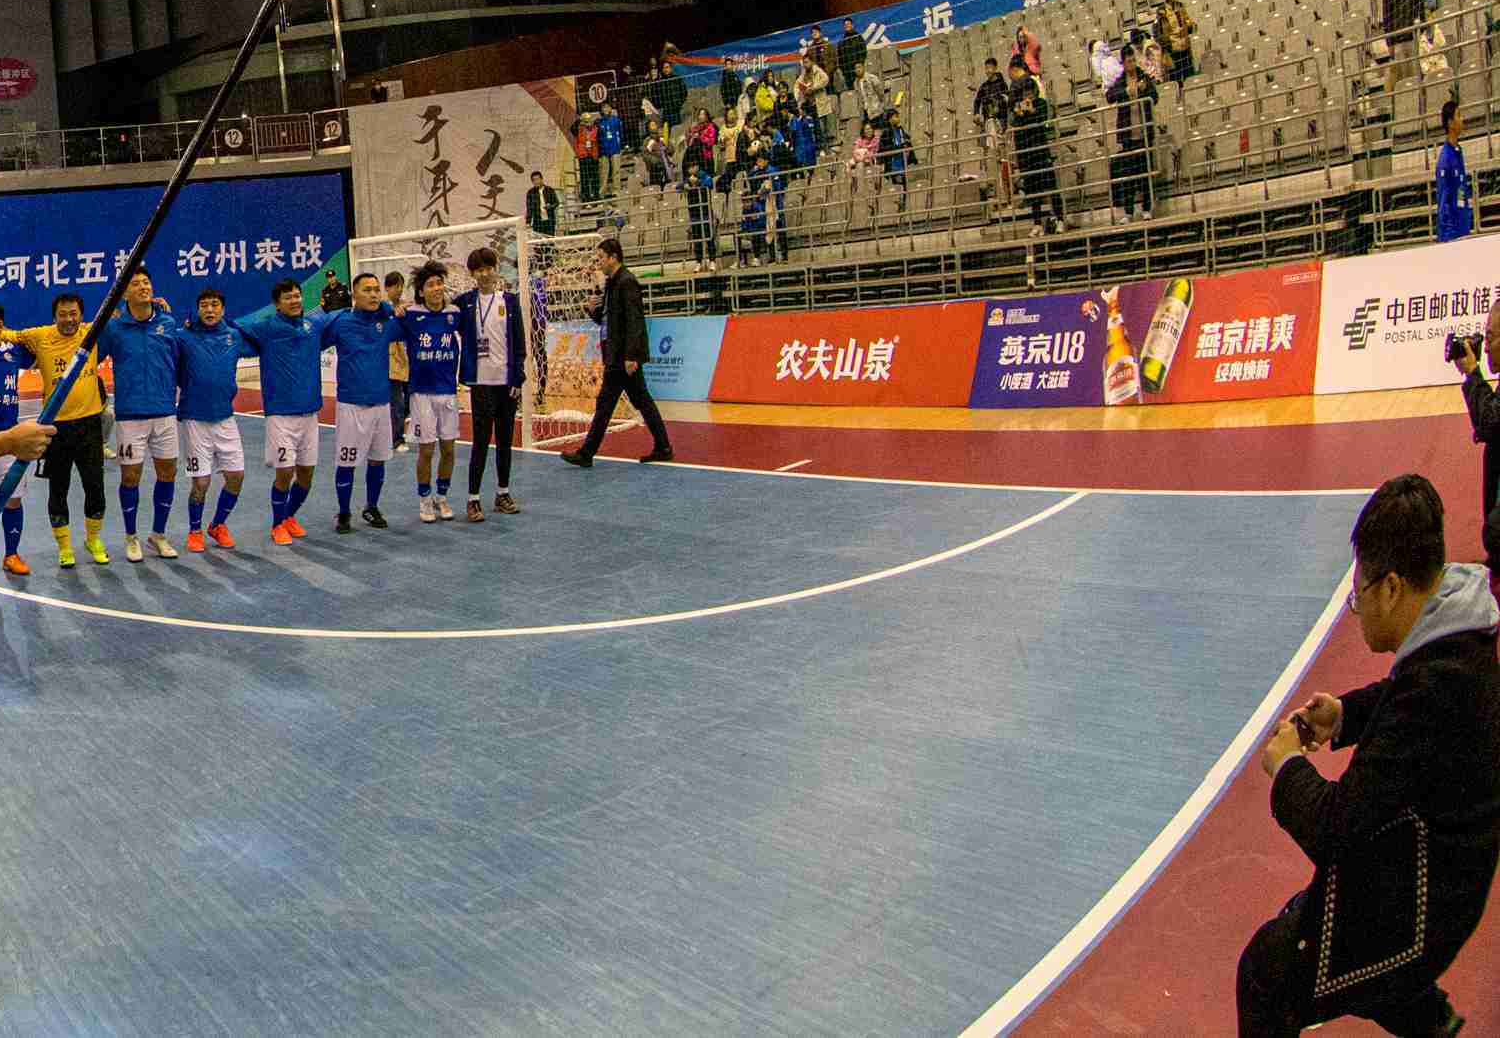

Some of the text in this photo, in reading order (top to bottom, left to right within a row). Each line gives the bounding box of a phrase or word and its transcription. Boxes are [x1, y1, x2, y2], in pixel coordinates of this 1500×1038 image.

[177, 234, 324, 278] 沧州来战
[419, 332, 452, 348] 沧州
[1194, 313, 1297, 359] 燕京清爽
[1384, 327, 1423, 344] POSTAL
[998, 330, 1085, 366] 燕京U8
[775, 335, 895, 381] 农夫山泉
[118, 443, 133, 459] 44
[278, 447, 287, 462] 2
[340, 446, 357, 462] 39
